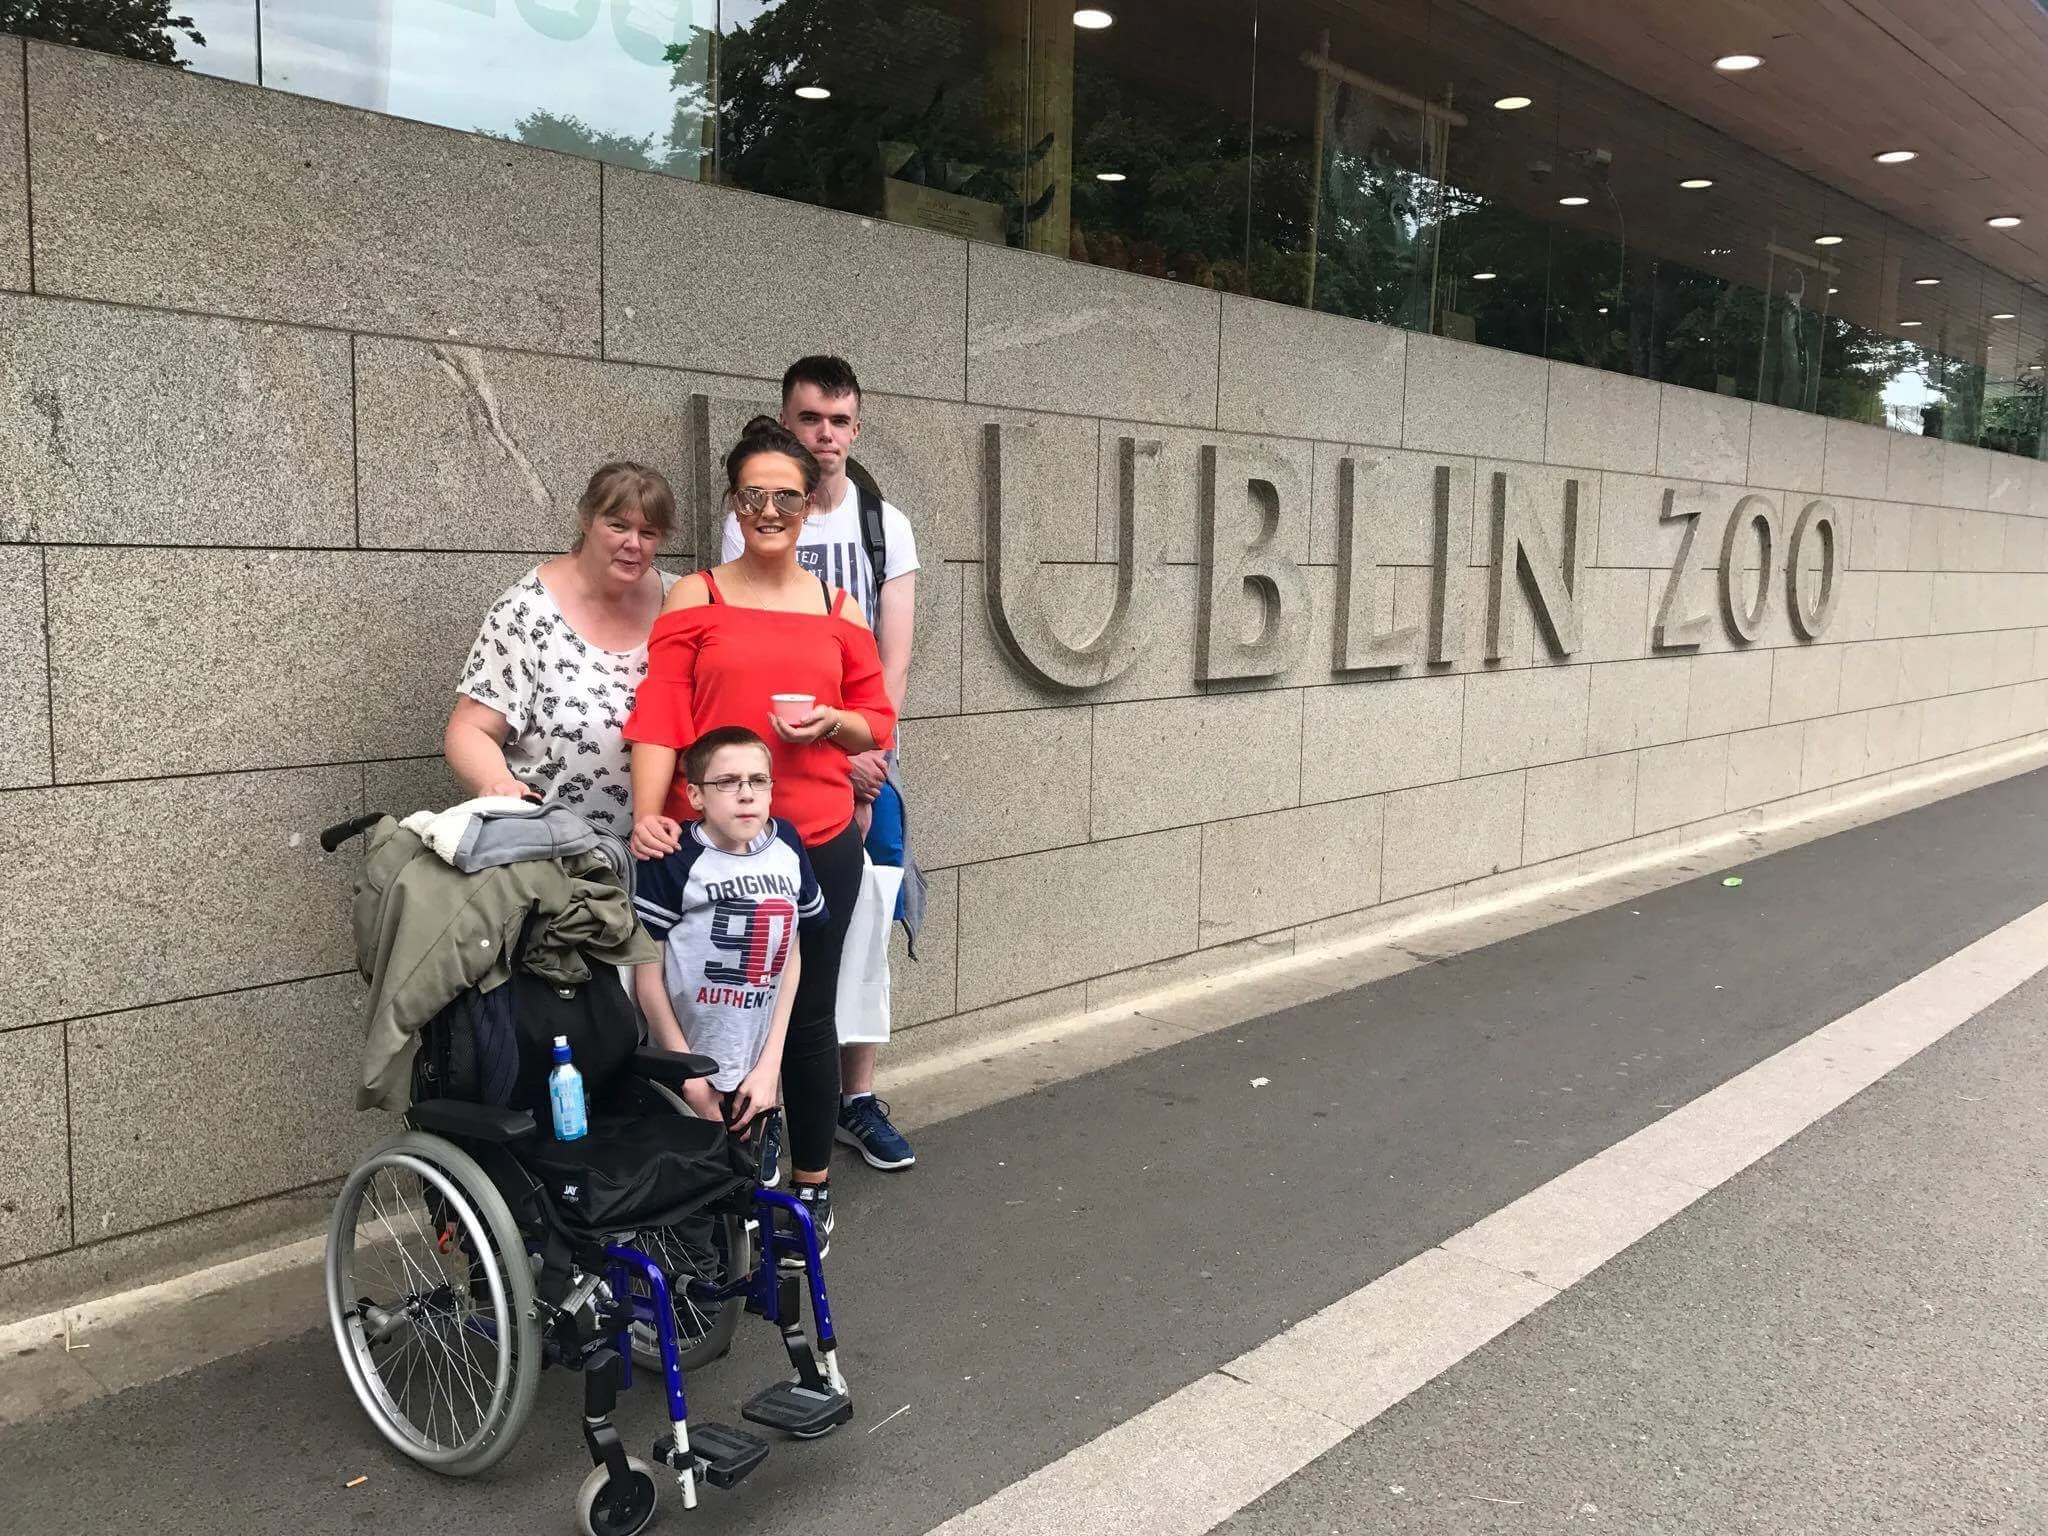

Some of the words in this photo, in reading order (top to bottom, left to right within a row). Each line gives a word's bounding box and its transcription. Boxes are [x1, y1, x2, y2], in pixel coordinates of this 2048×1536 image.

[690, 394, 1588, 694] UBLIN
[1653, 487, 1843, 655] ZOO
[795, 550, 819, 564] TED
[705, 874, 797, 902] ORIGINAL
[704, 898, 794, 987] 90
